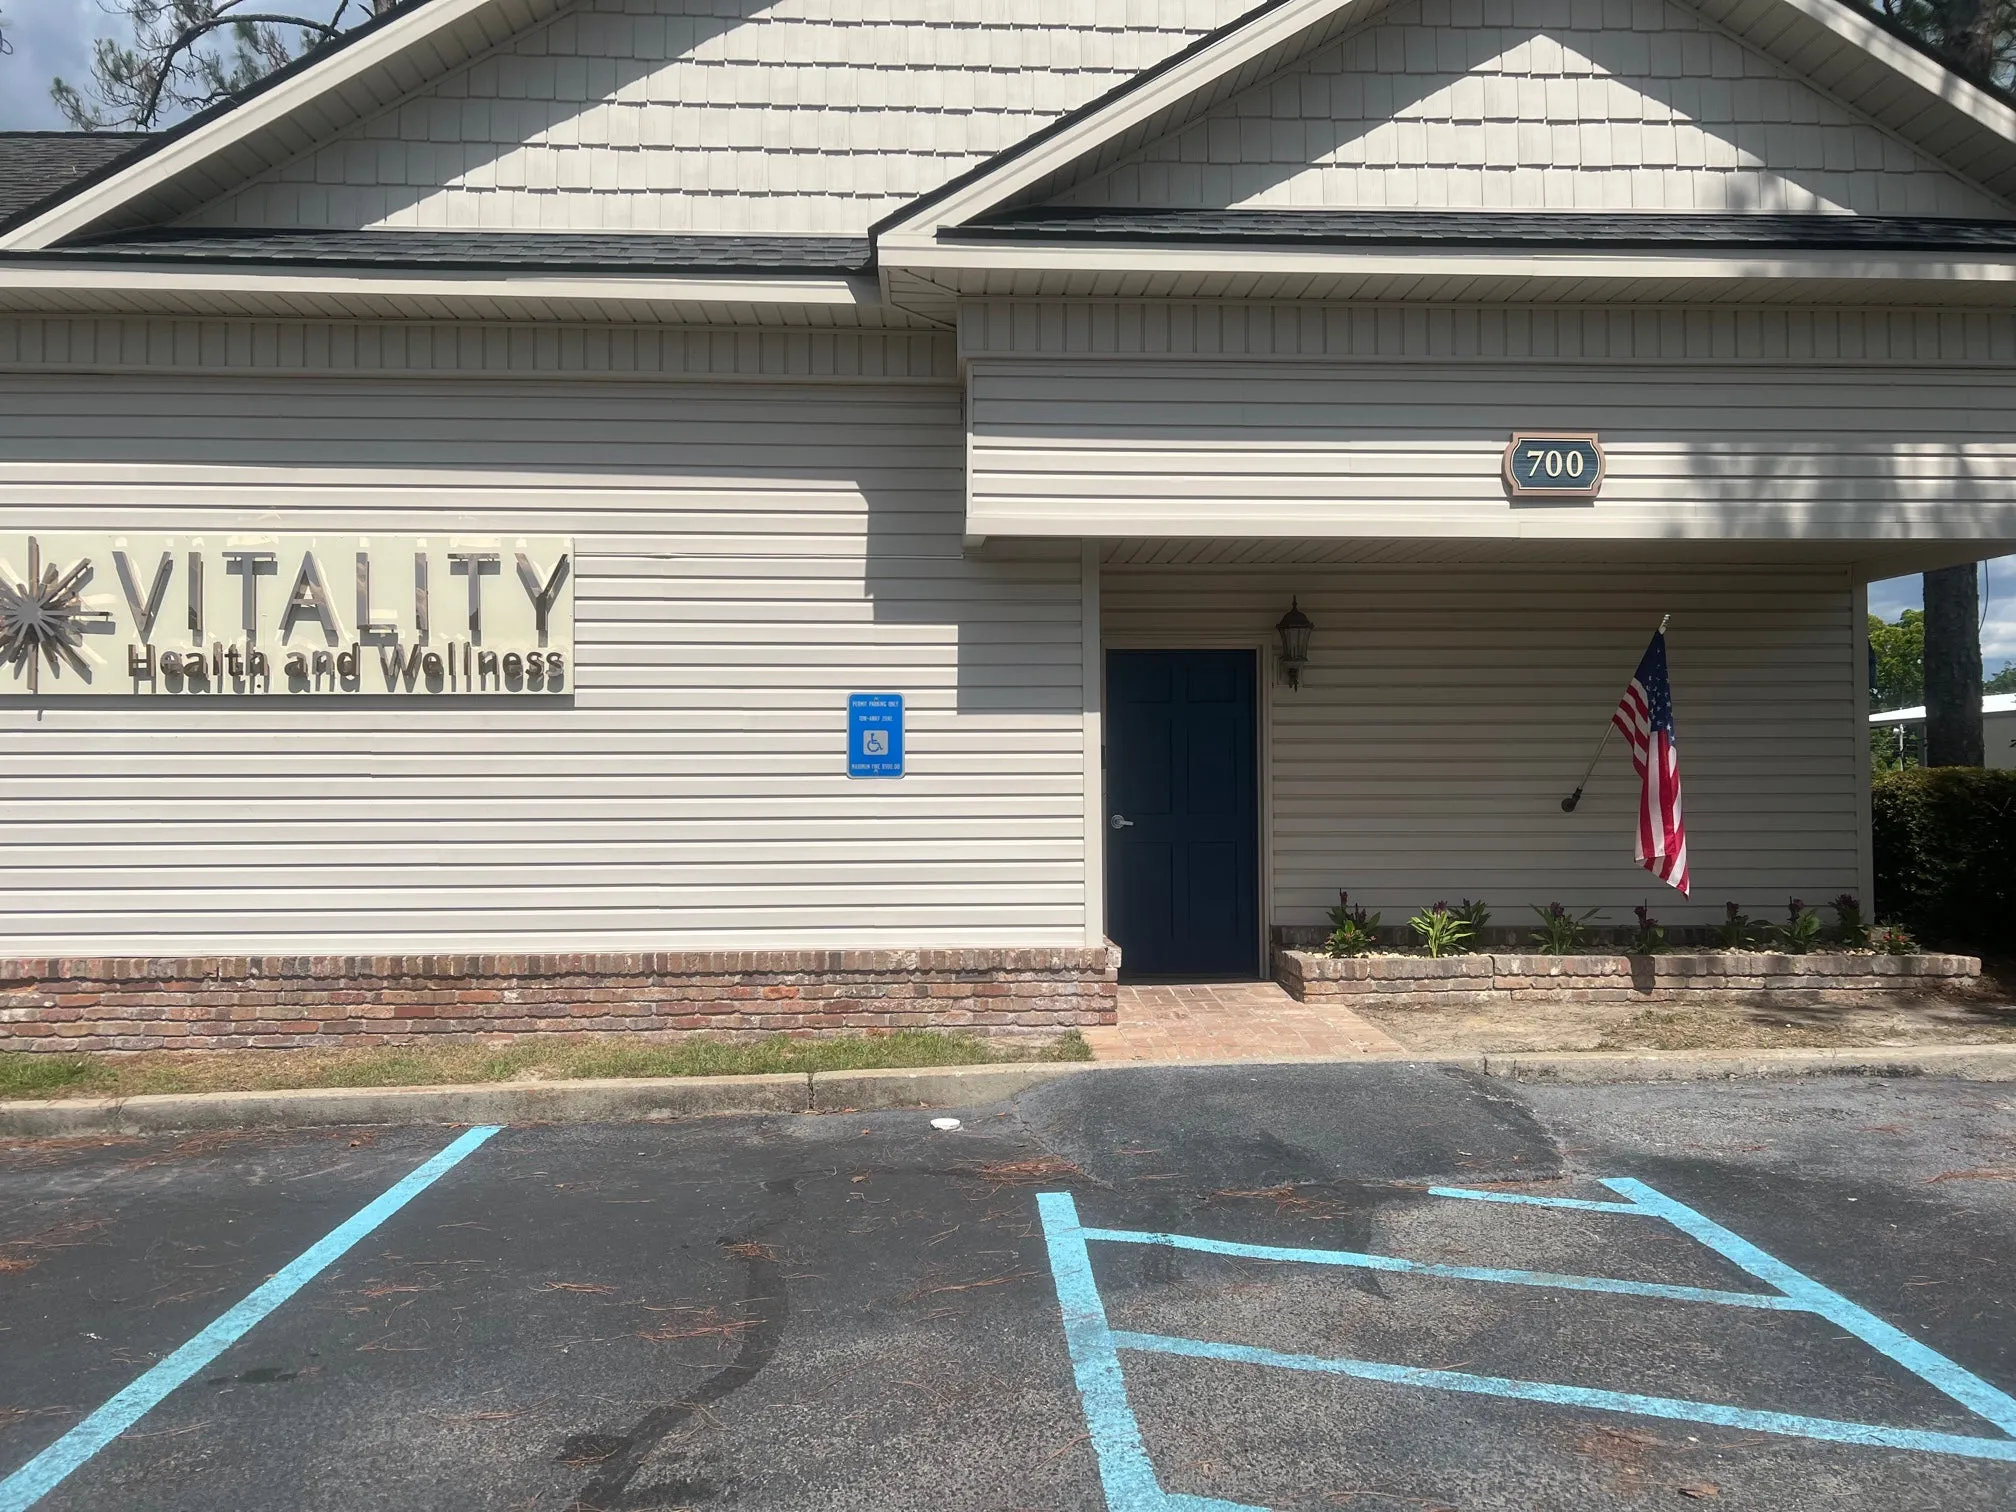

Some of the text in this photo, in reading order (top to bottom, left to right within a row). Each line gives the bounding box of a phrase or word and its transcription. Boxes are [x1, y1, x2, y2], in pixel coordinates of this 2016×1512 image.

[1527, 450, 1584, 477] 700
[112, 551, 569, 632] VITALITY
[128, 641, 565, 679] Health and Wellness
[852, 700, 899, 708] PERMIT PARKING ONLY
